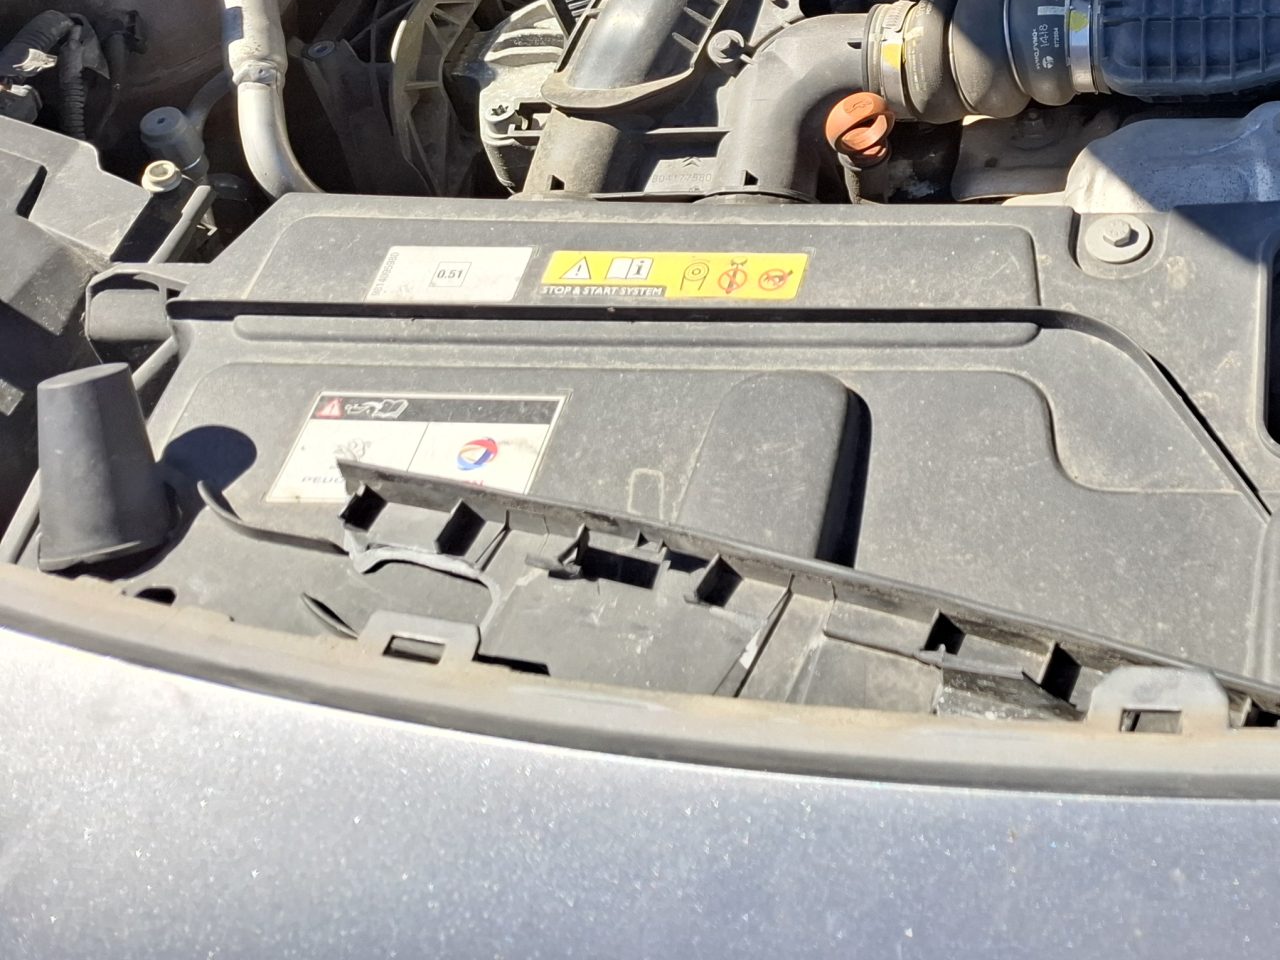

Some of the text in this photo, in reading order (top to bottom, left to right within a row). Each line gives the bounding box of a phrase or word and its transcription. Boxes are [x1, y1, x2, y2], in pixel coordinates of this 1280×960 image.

[437, 269, 464, 279] 0.51
[541, 285, 663, 297] STOP & START SYSTEM
